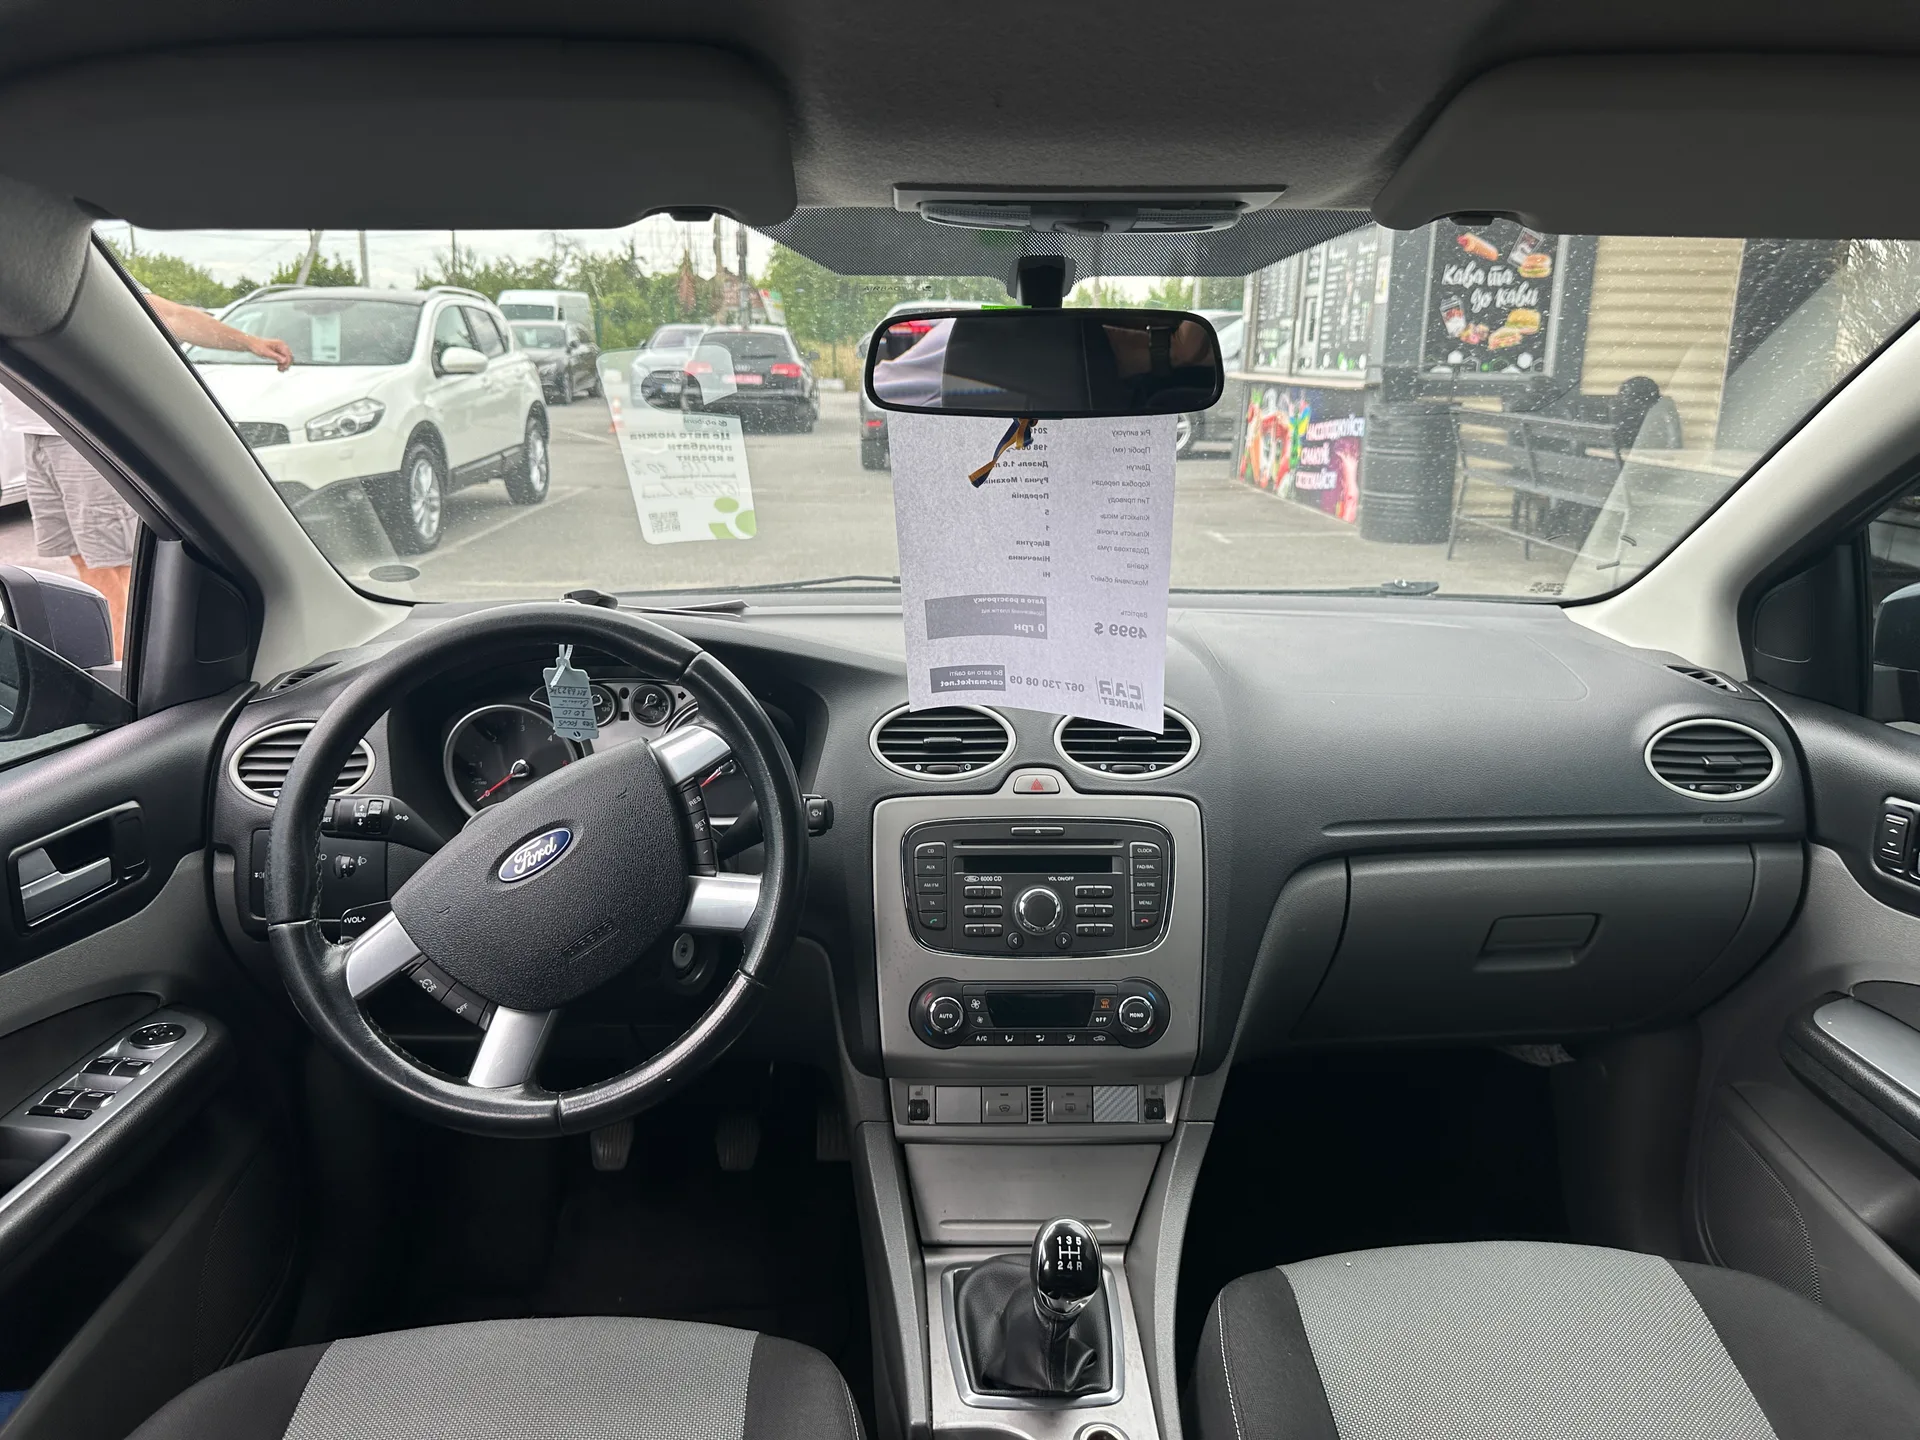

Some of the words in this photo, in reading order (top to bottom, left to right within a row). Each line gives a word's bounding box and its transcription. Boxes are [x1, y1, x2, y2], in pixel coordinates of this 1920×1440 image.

[1442, 260, 1486, 288] Кава
[1487, 265, 1514, 287] та
[1470, 288, 1492, 313] до
[1495, 281, 1539, 308] кави
[689, 796, 702, 806] RES
[694, 818, 706, 829] SET
[514, 836, 557, 874] Ford
[455, 1003, 468, 1014] OFF
[1056, 1236, 1062, 1244] 1
[1065, 1236, 1072, 1244] 3
[1075, 1236, 1082, 1245] 5
[1057, 1261, 1063, 1270] 2
[1067, 1261, 1073, 1270] 4
[1076, 1261, 1083, 1270] R
